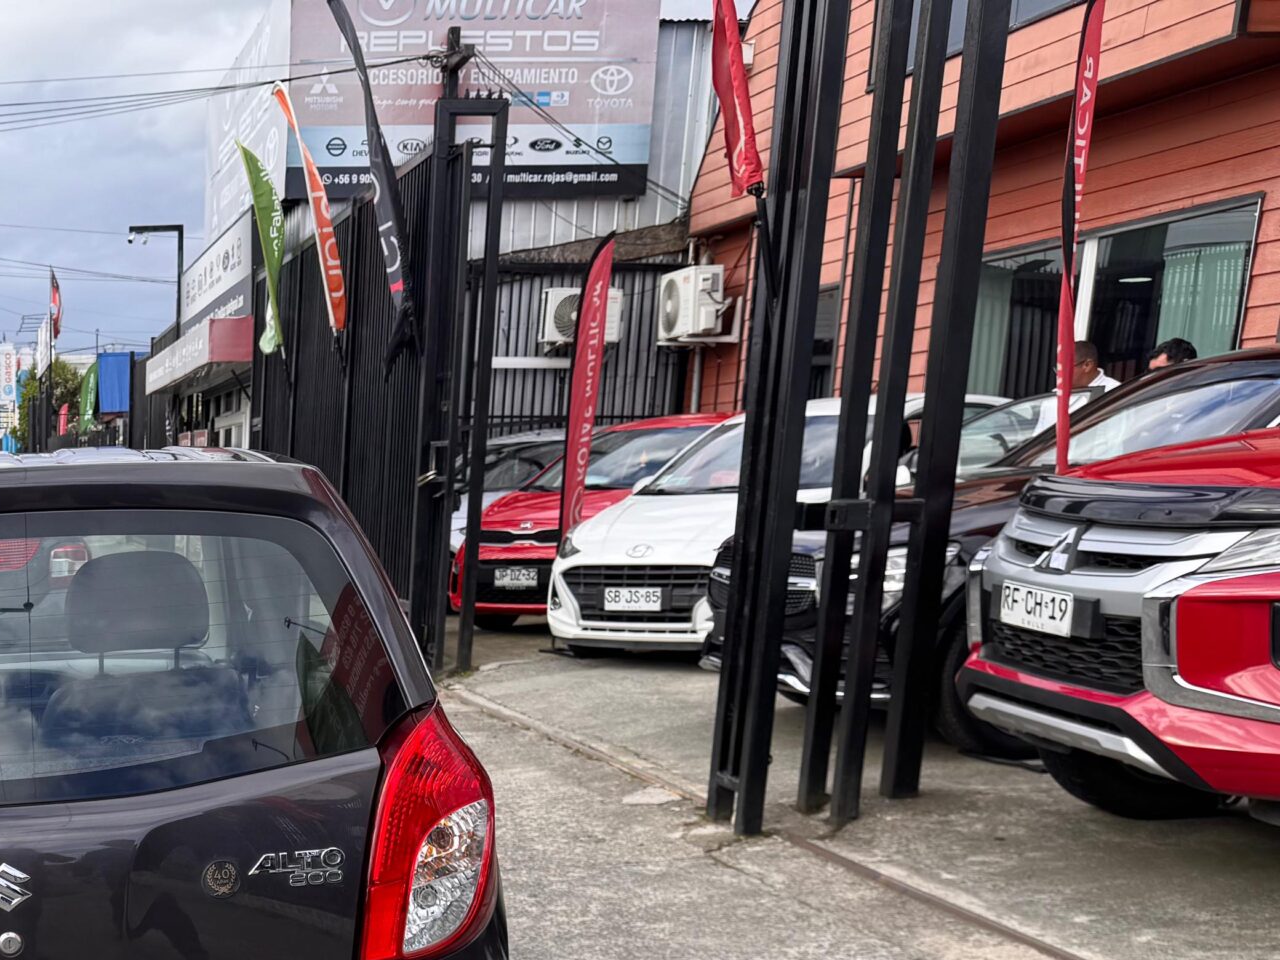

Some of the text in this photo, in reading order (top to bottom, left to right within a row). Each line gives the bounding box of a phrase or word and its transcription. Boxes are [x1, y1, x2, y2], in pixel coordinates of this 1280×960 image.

[424, 0, 587, 21] MULTICAR
[340, 30, 600, 53] REPUESTOS
[366, 69, 447, 86] CCESORIO
[470, 67, 578, 85] EQUIPAMIENTO
[587, 98, 634, 109] TOYOTA
[534, 140, 556, 150] Ford
[333, 174, 350, 184] +56
[352, 174, 358, 184] 9
[248, 847, 346, 876] ALTO
[213, 868, 230, 880] 40
[289, 869, 344, 887] 800
